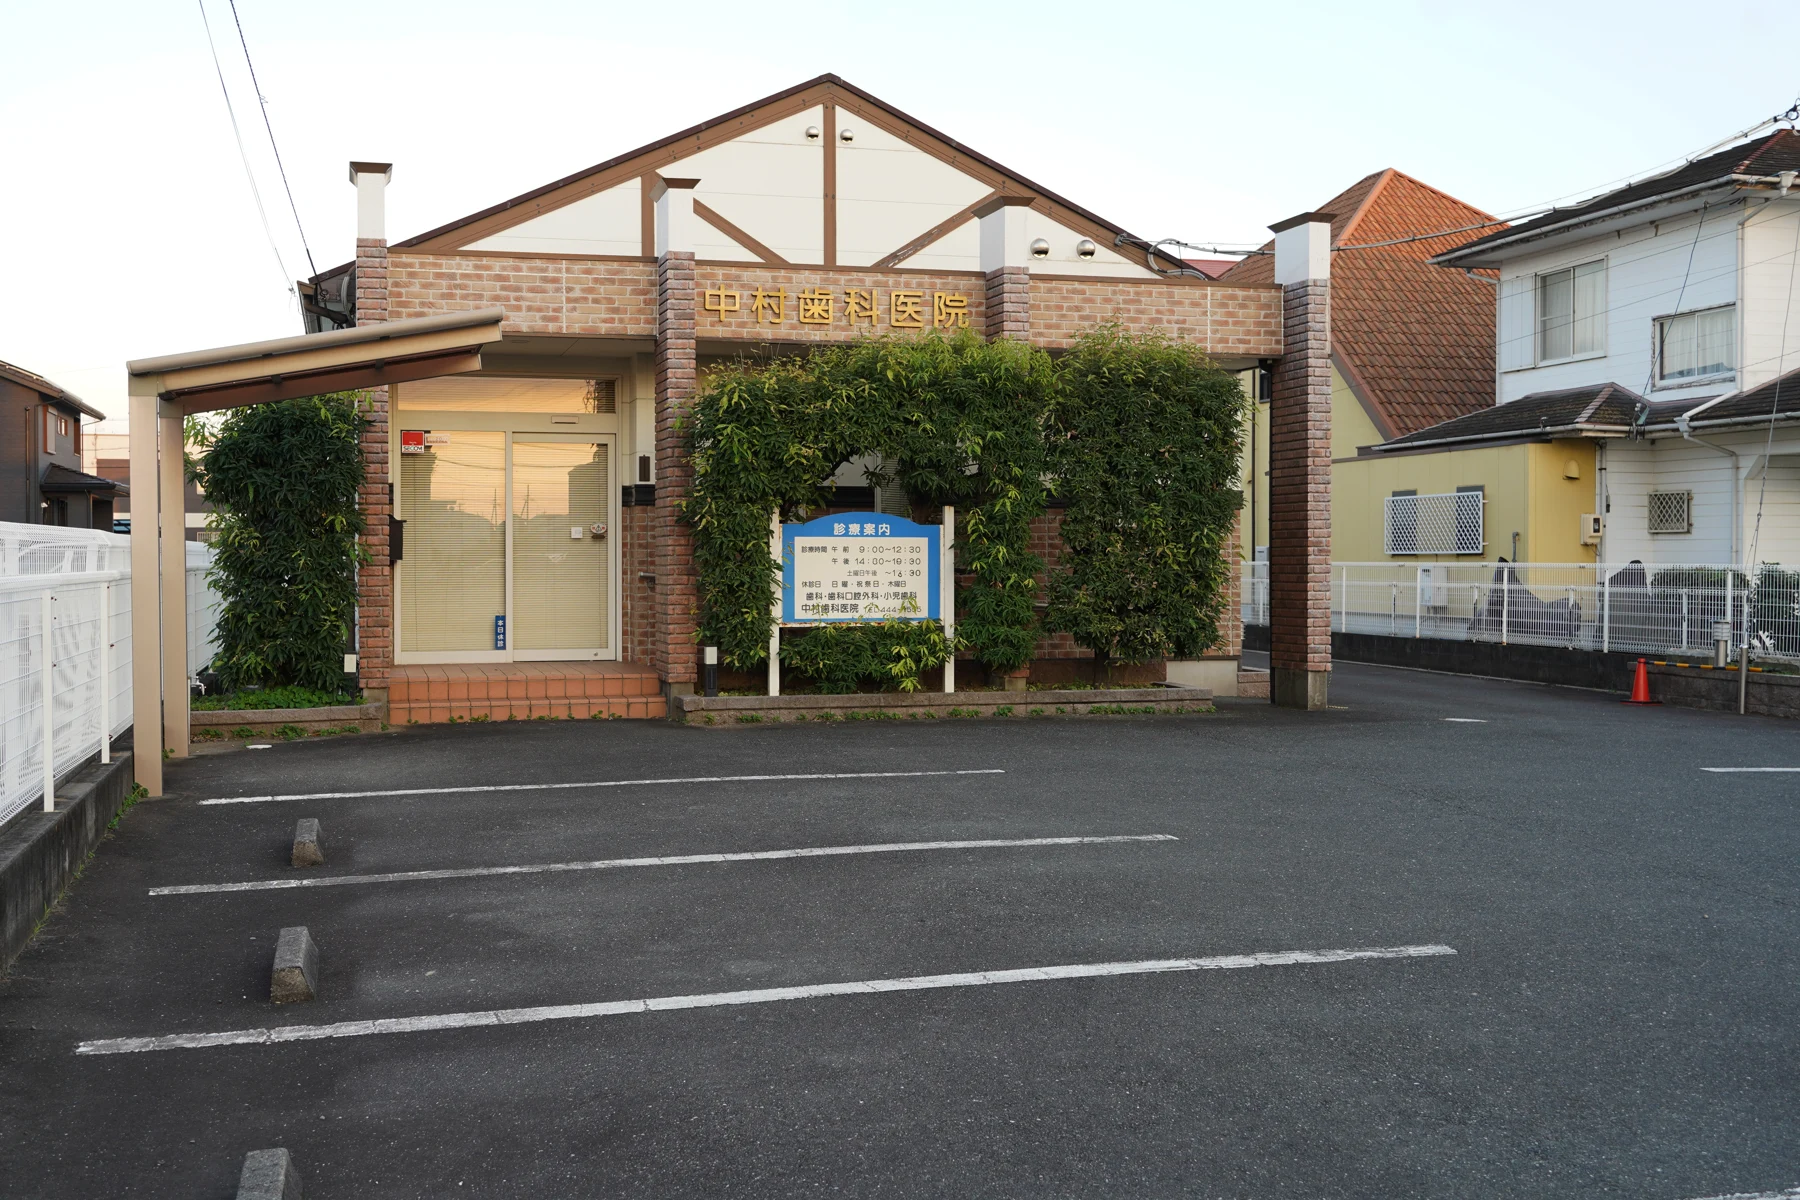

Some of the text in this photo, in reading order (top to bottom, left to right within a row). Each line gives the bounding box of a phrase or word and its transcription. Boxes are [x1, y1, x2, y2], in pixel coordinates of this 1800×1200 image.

[704, 284, 969, 328] 中村歯科医院
[833, 523, 891, 536] 診療案内
[801, 603, 860, 614] 中村歯科医院
